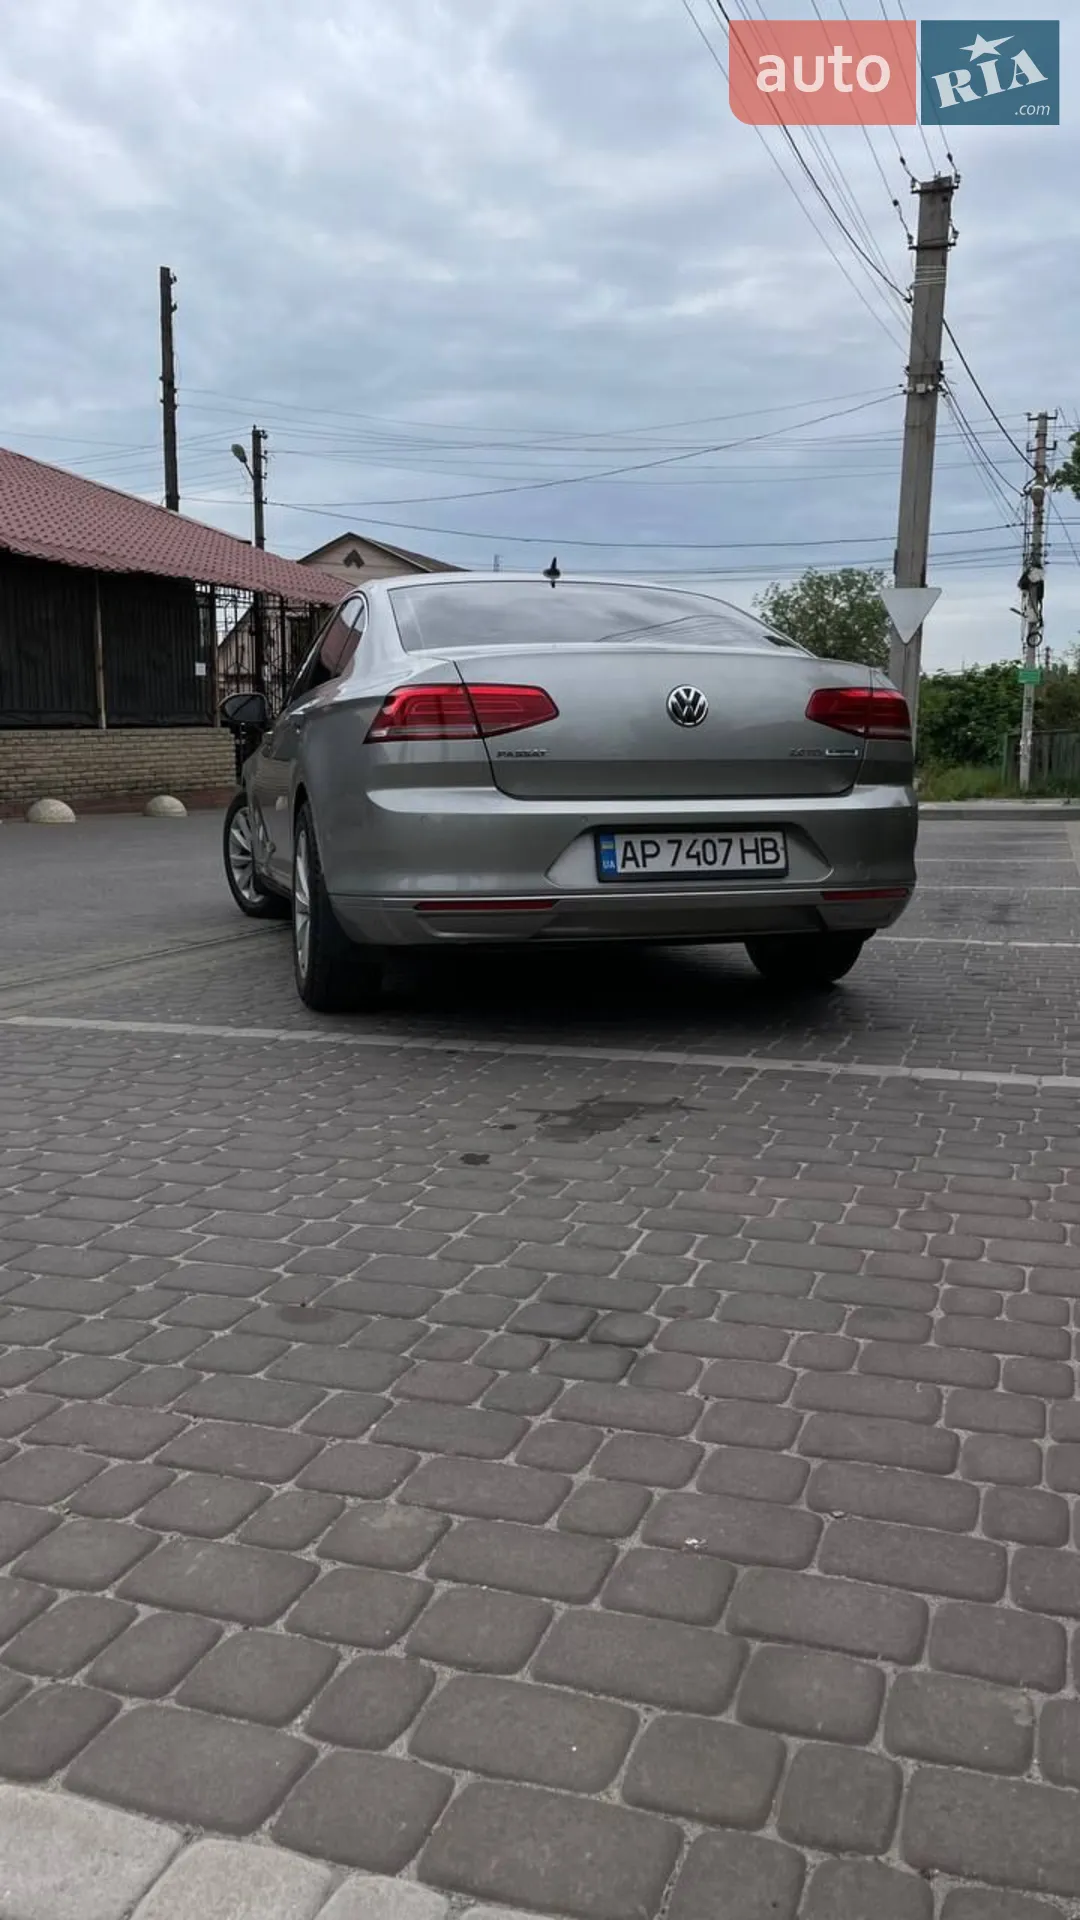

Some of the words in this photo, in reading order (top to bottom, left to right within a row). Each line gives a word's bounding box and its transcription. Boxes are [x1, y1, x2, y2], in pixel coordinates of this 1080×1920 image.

[620, 839, 661, 869] AP
[667, 837, 733, 867] 7407
[739, 837, 781, 866] HB
[602, 859, 616, 870] UA
